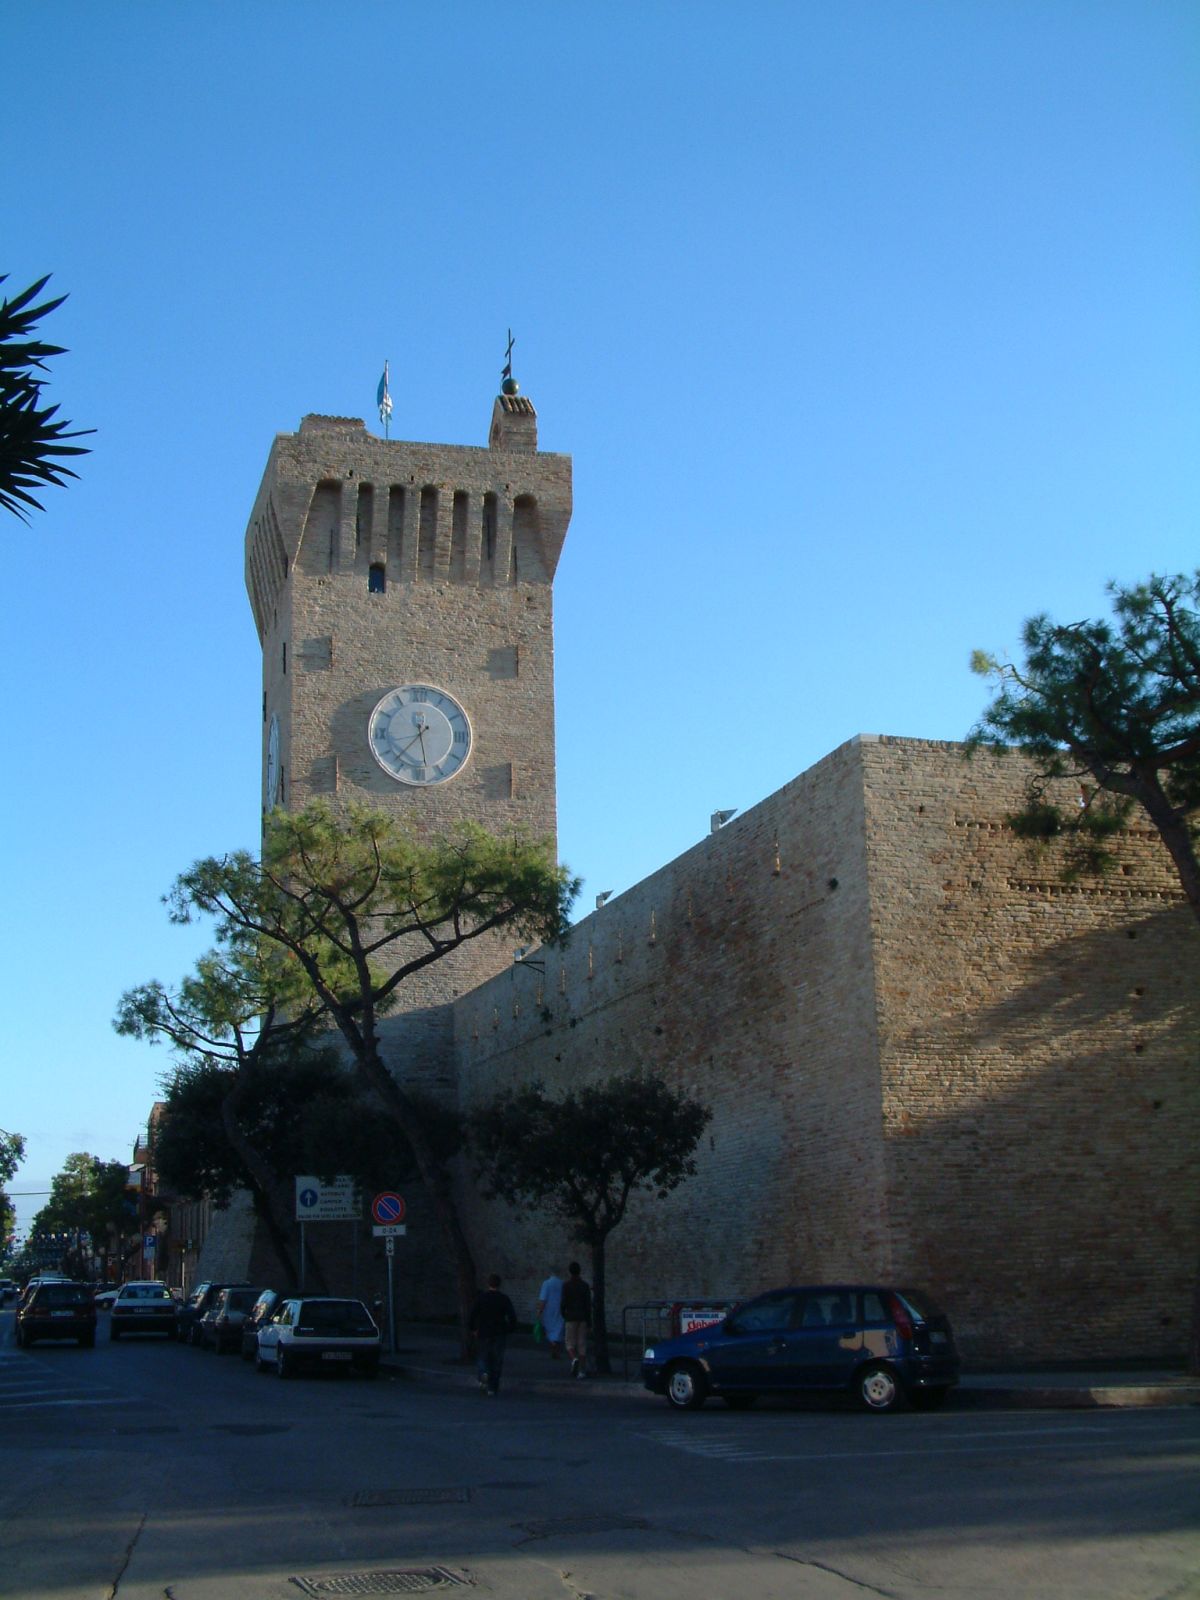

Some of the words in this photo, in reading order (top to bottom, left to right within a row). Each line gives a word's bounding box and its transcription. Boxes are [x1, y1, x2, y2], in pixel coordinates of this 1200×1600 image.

[411, 690, 427, 703] XII
[375, 727, 386, 740] IX
[454, 731, 465, 743] III
[146, 1236, 153, 1246] P
